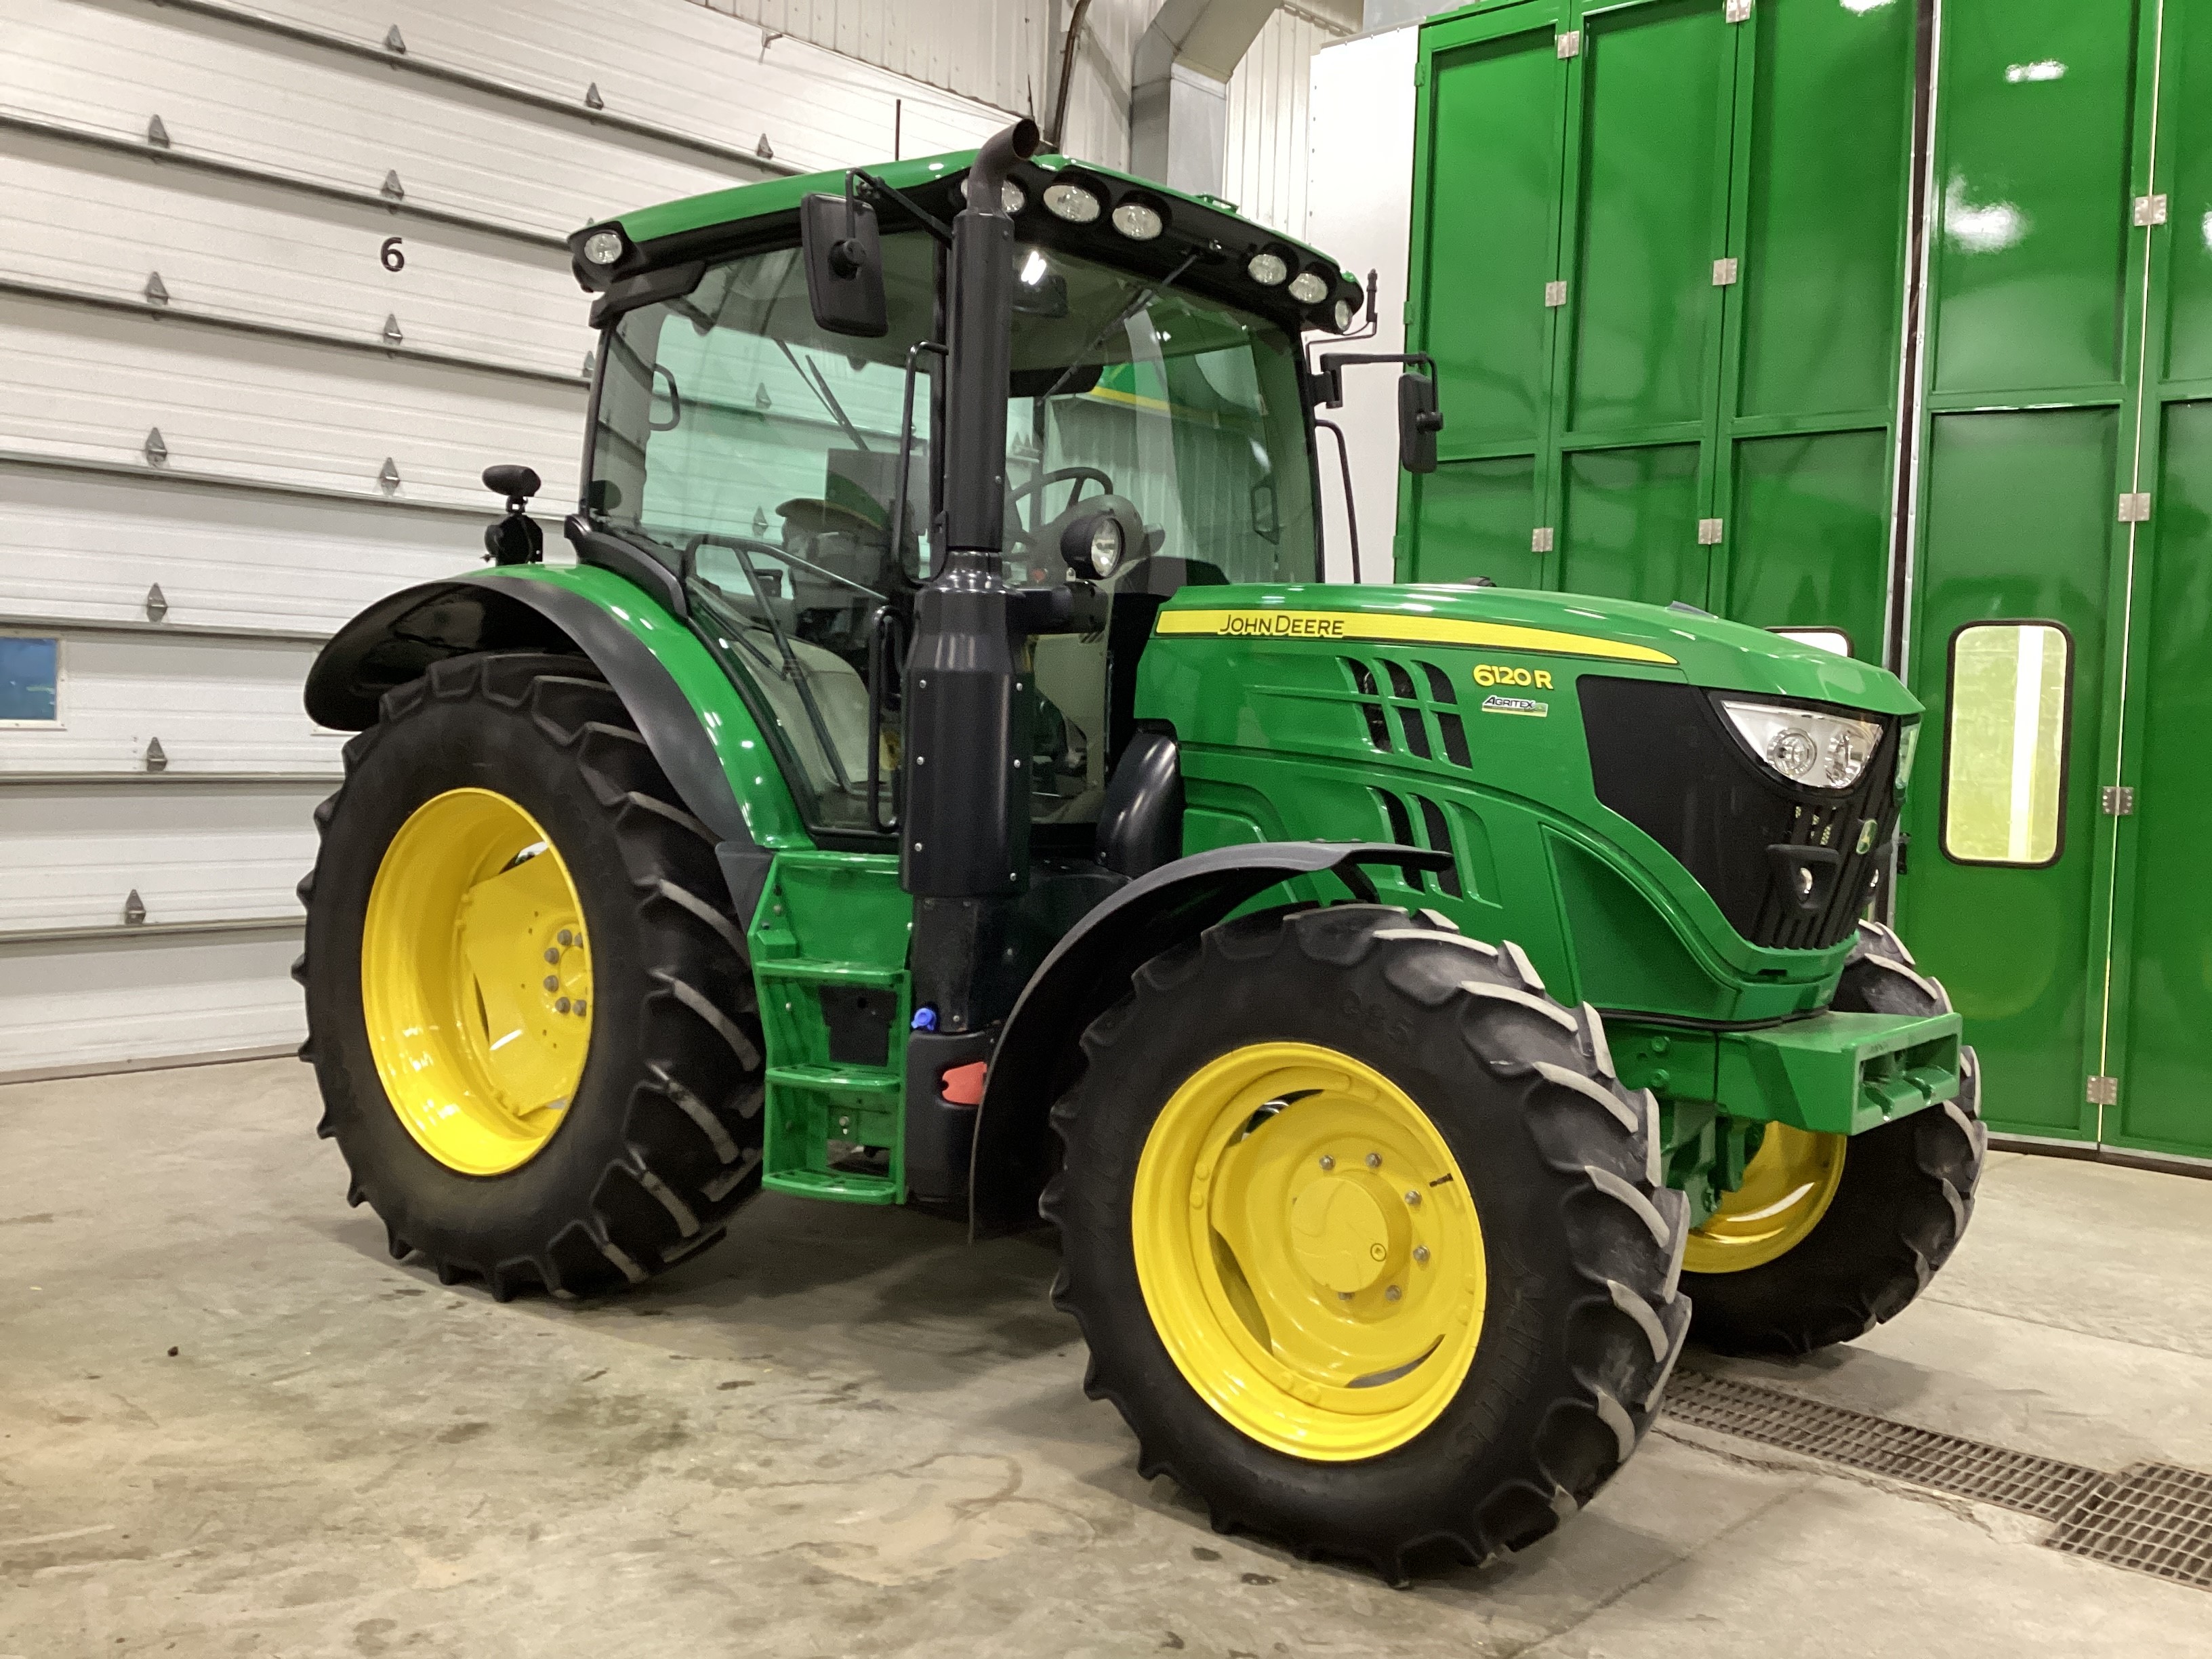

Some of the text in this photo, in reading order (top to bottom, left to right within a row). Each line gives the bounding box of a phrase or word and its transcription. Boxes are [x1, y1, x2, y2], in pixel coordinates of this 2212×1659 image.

[381, 237, 405, 272] 6
[1219, 614, 1345, 636] JOHN DEERE
[1484, 696, 1534, 709] AGRITEX
